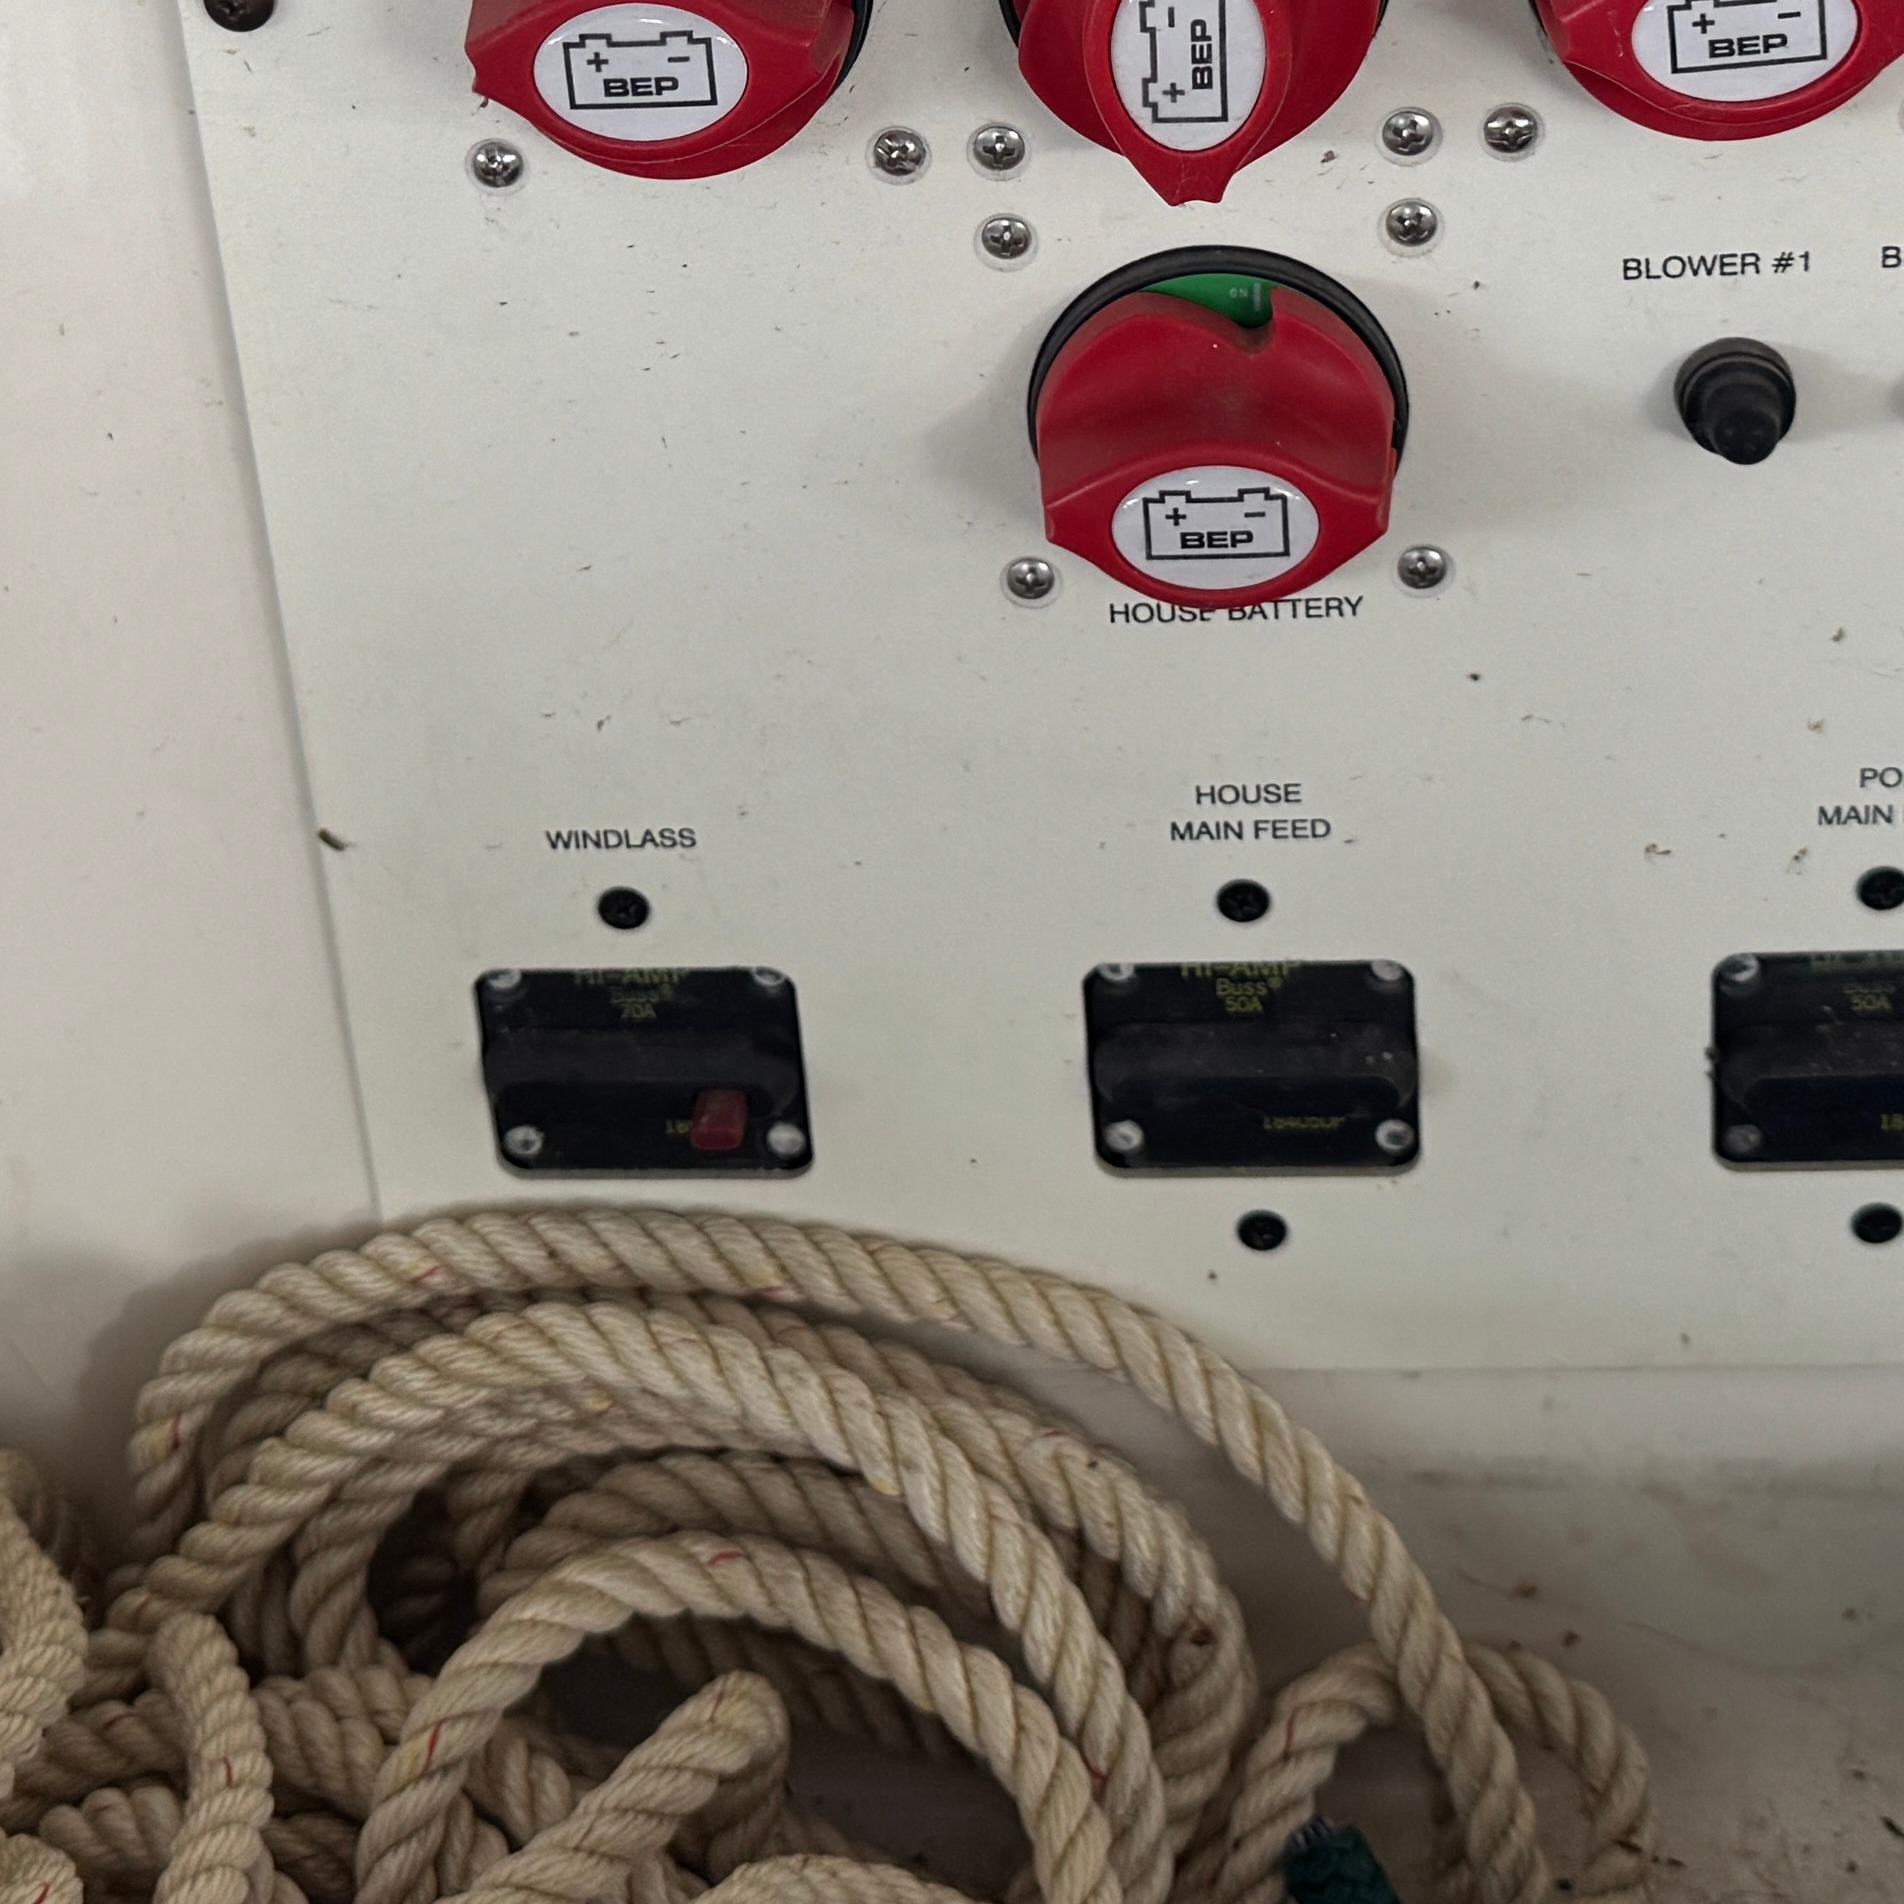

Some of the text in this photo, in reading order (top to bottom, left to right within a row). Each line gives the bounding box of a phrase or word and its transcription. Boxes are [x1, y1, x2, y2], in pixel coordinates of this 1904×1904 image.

[1188, 17, 1215, 92] BEP
[1705, 31, 1790, 62] BEP
[601, 75, 681, 97] BEP
[1622, 250, 1810, 281] BLOWER #1
[1179, 529, 1255, 550] BEP
[1195, 782, 1303, 806] HOUSE
[1817, 804, 1894, 826] MAIN
[545, 827, 697, 851] WINDLASS
[1170, 818, 1332, 842] MAIN FEED
[1850, 992, 1893, 1012] 50A
